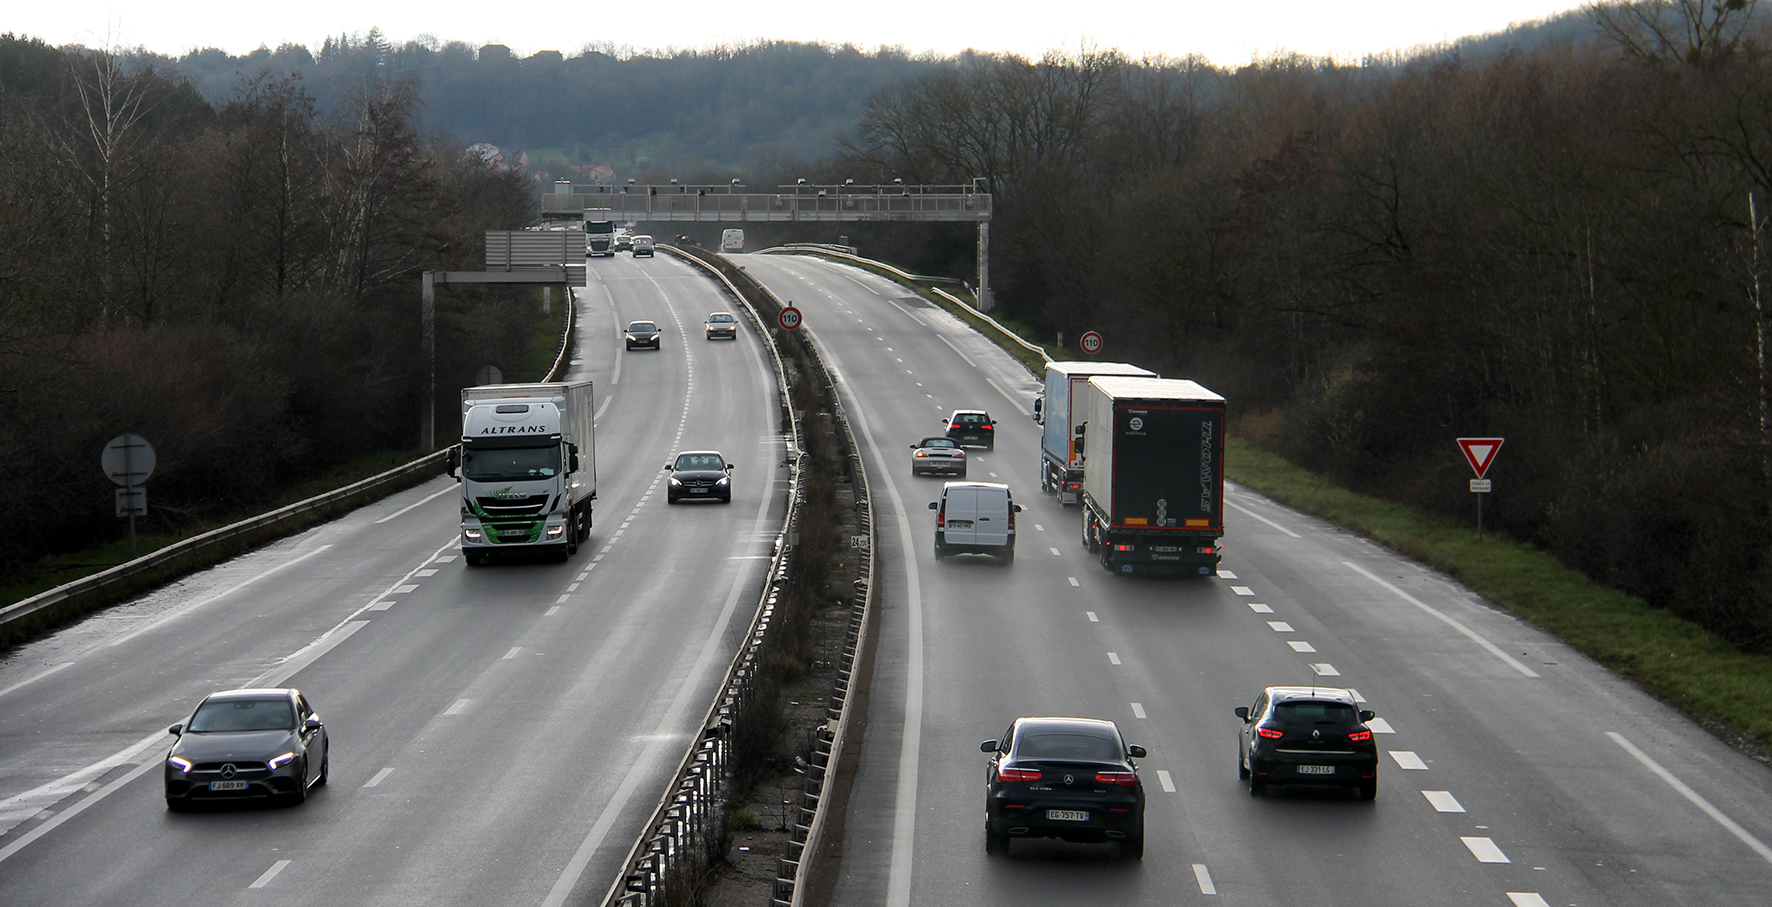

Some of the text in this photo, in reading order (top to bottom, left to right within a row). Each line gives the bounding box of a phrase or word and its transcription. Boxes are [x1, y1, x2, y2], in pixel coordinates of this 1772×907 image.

[783, 314, 798, 323] 110
[1085, 339, 1099, 347] 110
[480, 425, 546, 435] ALTRANS
[1200, 420, 1212, 512] THOMAS
[851, 537, 859, 547] 24
